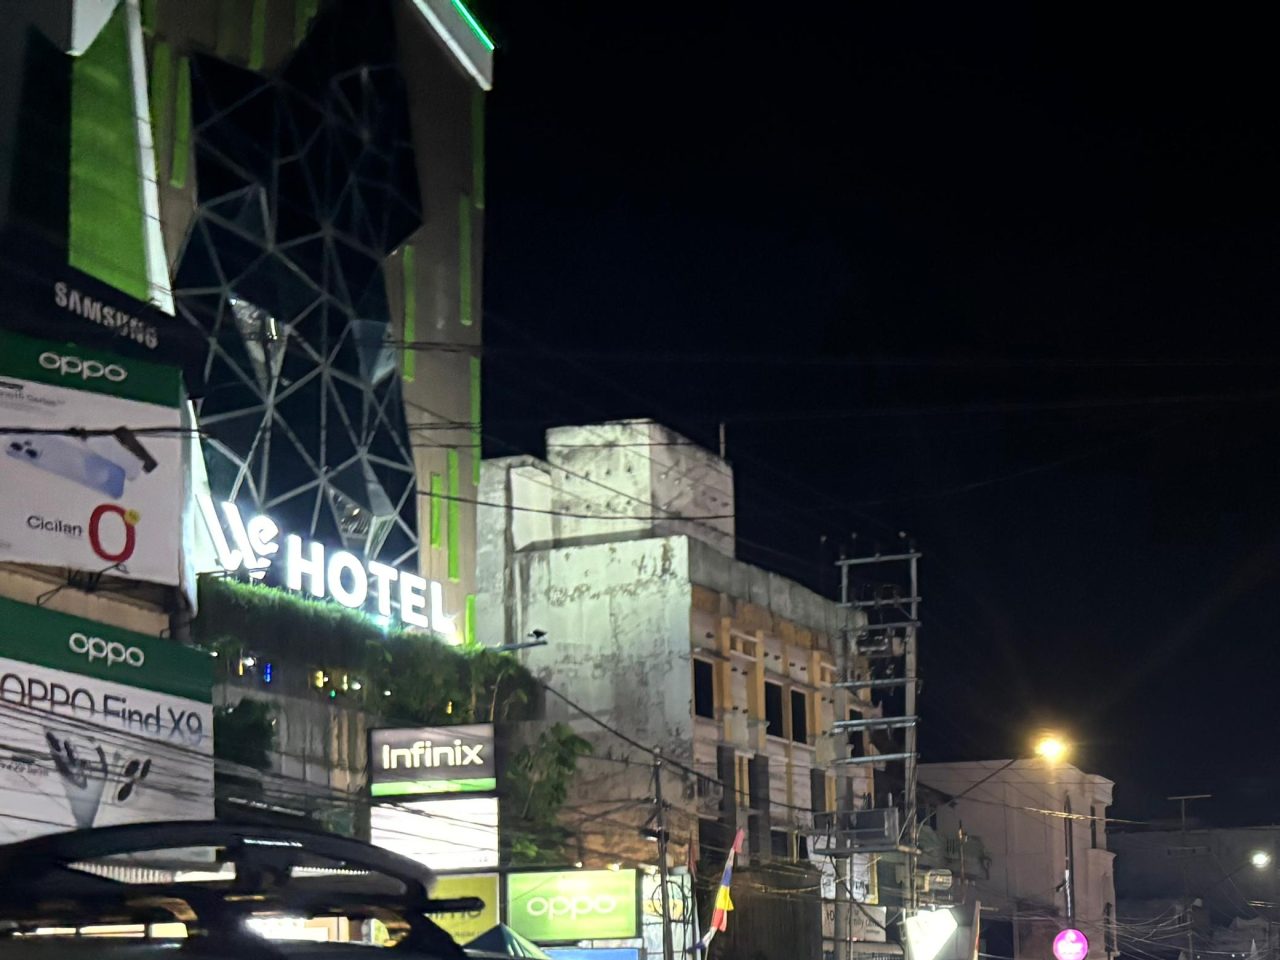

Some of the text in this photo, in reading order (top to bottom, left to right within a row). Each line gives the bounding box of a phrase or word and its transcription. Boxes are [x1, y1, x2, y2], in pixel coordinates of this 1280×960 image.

[38, 352, 128, 381] oppo
[26, 514, 83, 537] Cicilan
[286, 533, 457, 635] HOTEL
[69, 632, 145, 668] oppo
[104, 693, 160, 735] Find
[383, 739, 484, 769] Infinix
[526, 894, 617, 920] oppo
